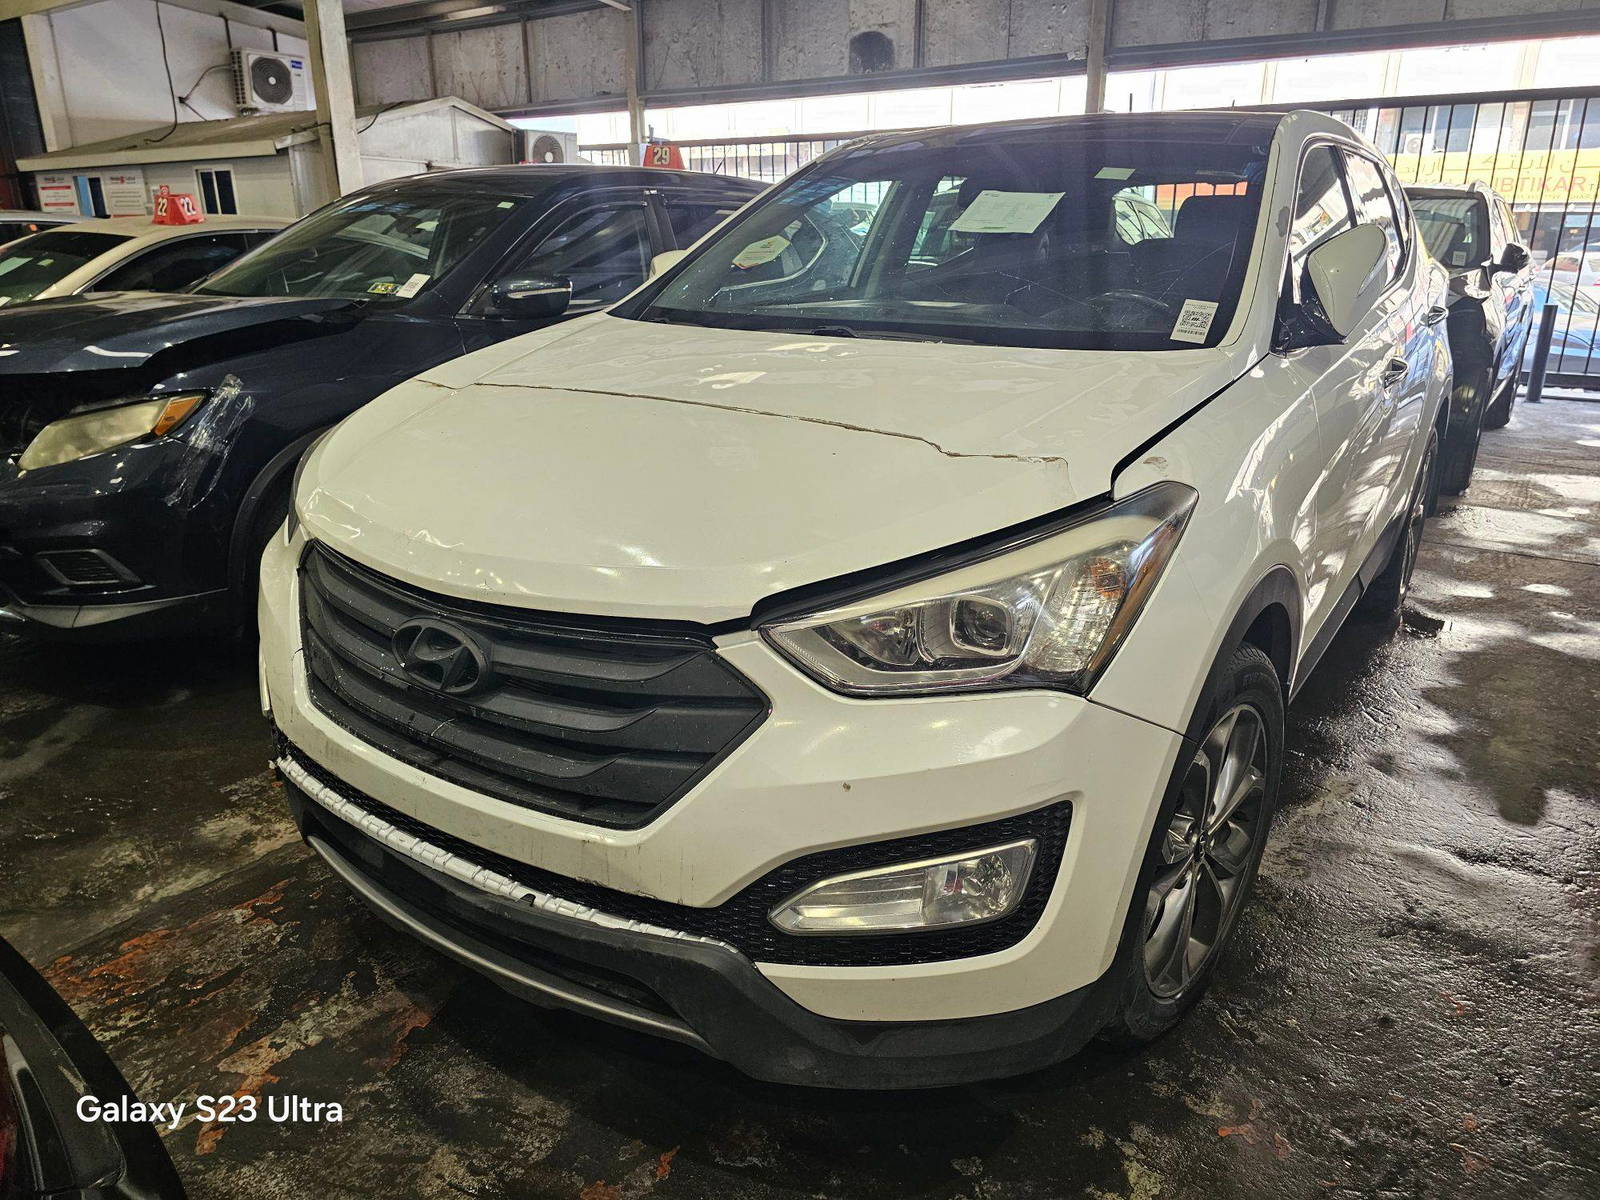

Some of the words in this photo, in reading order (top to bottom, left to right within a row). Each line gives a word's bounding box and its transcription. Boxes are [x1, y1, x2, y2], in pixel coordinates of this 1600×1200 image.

[653, 147, 670, 165] 29
[157, 197, 168, 216] 22
[180, 197, 197, 216] 22
